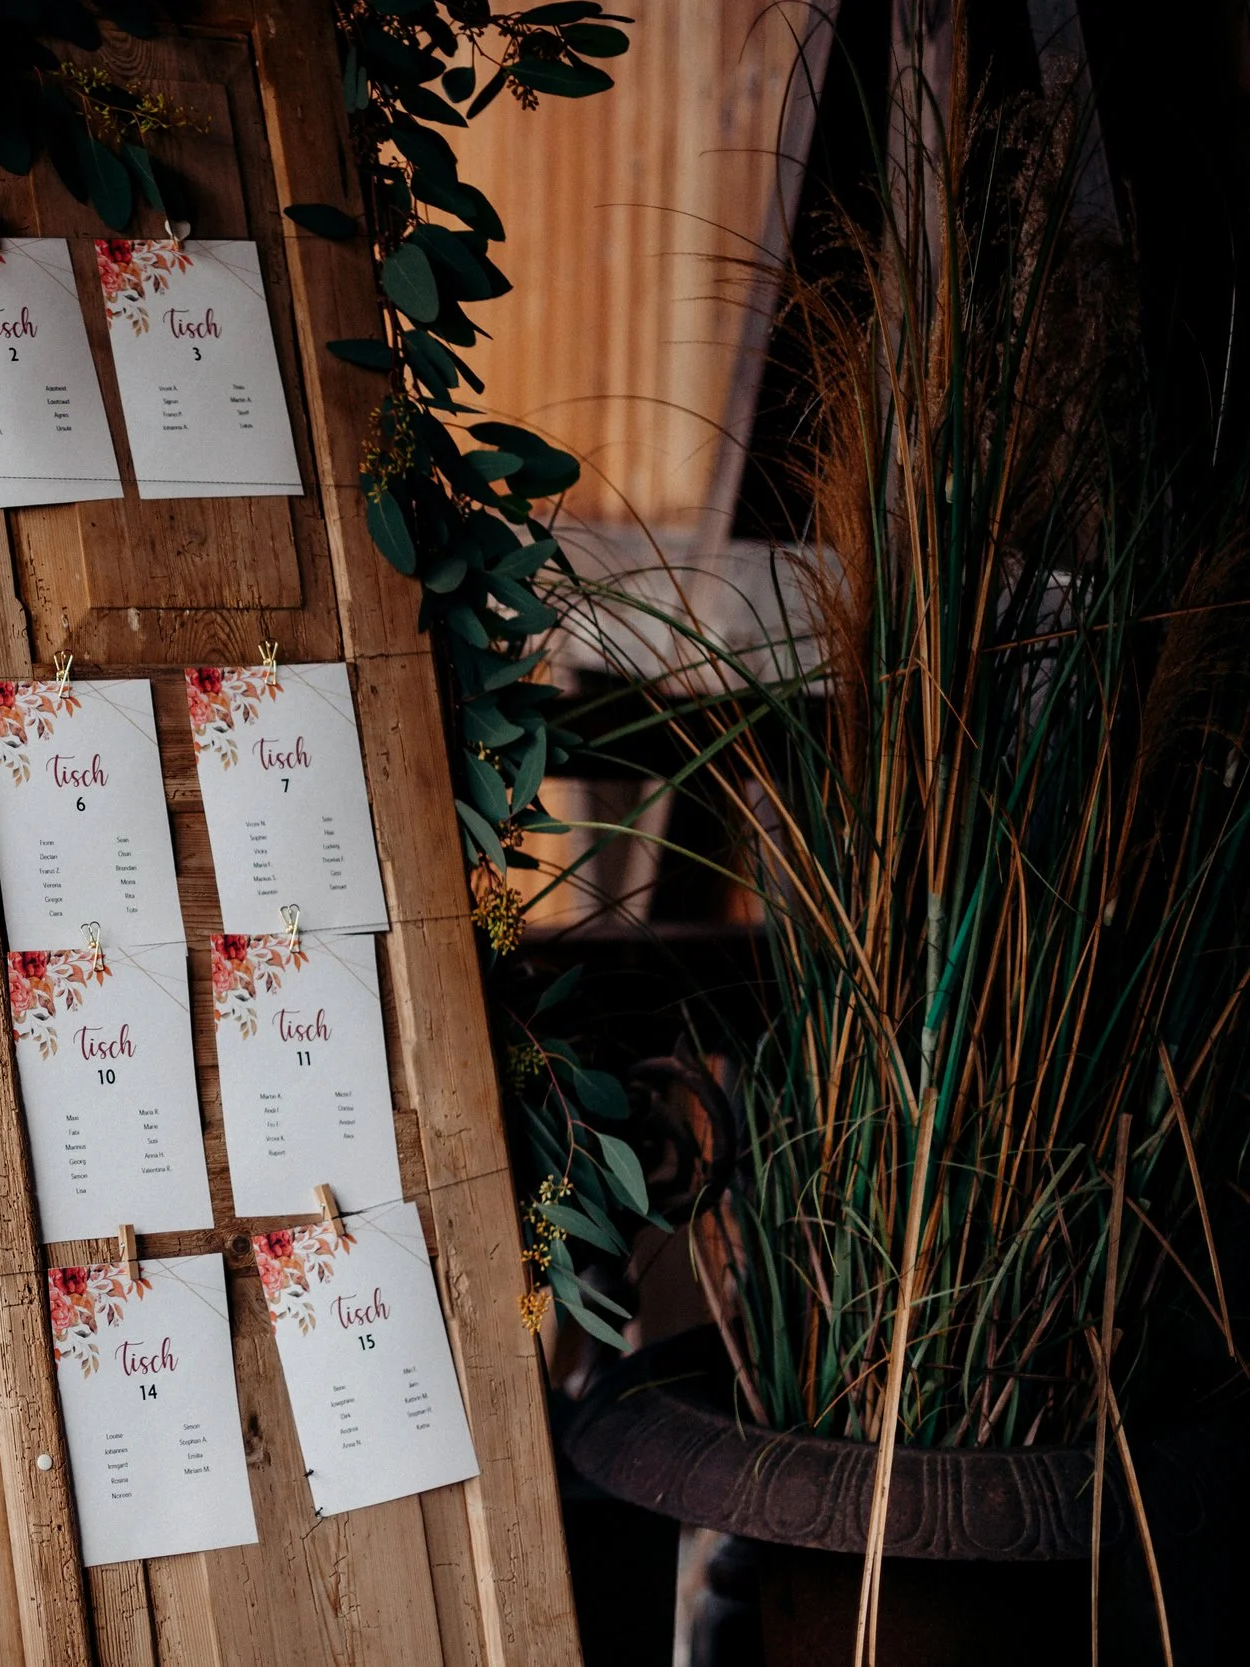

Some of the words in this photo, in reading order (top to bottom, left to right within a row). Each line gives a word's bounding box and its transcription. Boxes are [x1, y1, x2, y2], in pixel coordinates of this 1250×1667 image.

[163, 307, 222, 339] Tisch
[8, 347, 19, 361] 2
[192, 347, 202, 361] 3
[252, 736, 312, 770] Tisch
[46, 754, 109, 788] Tisch
[281, 778, 290, 793] 7
[76, 796, 86, 811] 6
[272, 1008, 332, 1042] Tisch
[73, 1023, 136, 1060] Tisch
[297, 1051, 311, 1066] 11
[98, 1069, 116, 1085] 10
[330, 1287, 390, 1329] Tisch
[358, 1334, 375, 1350] 15
[115, 1336, 179, 1376] Tisch
[139, 1384, 157, 1400] 14
